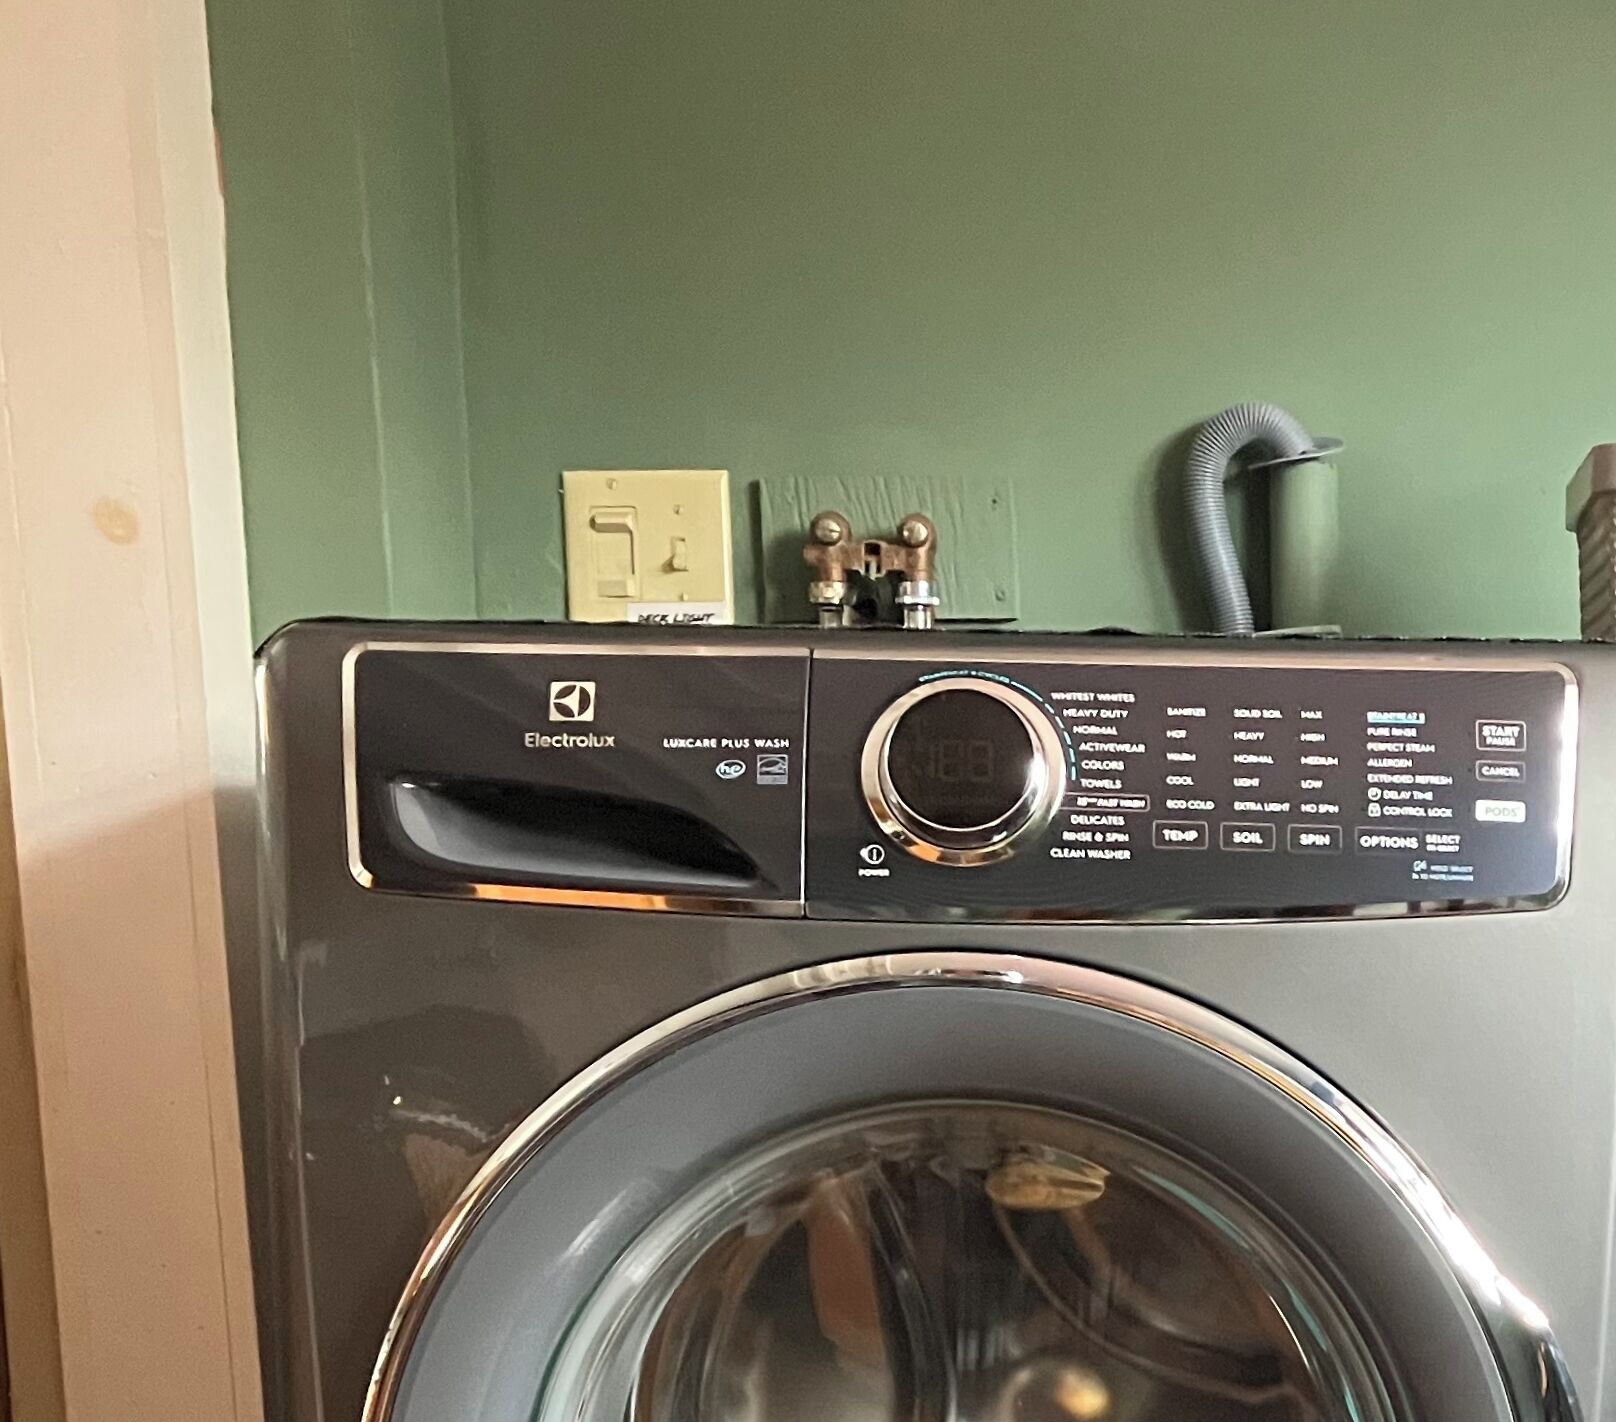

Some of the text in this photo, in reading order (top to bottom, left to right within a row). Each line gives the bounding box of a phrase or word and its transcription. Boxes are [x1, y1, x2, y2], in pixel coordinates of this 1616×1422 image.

[1051, 692, 1135, 703] WHITEST WHITES
[1063, 708, 1128, 718] HEAVY DUTY
[1073, 726, 1118, 735] NORMAL
[1166, 729, 1187, 738] HOT
[1233, 731, 1264, 740] HEAVY
[1482, 725, 1520, 738] START
[524, 733, 615, 748] Electrolux
[663, 738, 789, 748] LUXCARE PLUS WASH
[1486, 736, 1516, 746] PAUSE
[1078, 742, 1145, 753] ACTIVEWEAR
[1405, 743, 1435, 753] STEAM
[1233, 754, 1274, 764] NORMAL
[1367, 758, 1412, 768] ALLERGEN
[1081, 760, 1124, 770] COLORS
[1482, 765, 1520, 777] CANCEL
[1080, 778, 1122, 789] TOWELS
[1166, 776, 1194, 785] COOL
[1300, 780, 1323, 789] LOW
[1383, 790, 1411, 799] DELAY
[1166, 799, 1215, 810] ECO COLD
[1233, 801, 1263, 811] EXTRA
[1301, 803, 1317, 813] NO
[1383, 806, 1453, 817] CONTROL LOCK
[1070, 815, 1125, 826] DELICATES
[1063, 831, 1129, 842] RINSE & SPIN
[1162, 829, 1199, 841] TEMP
[1232, 831, 1263, 844] SOIL
[1299, 833, 1330, 846] SPIN
[1425, 834, 1460, 844] SELECT
[1360, 835, 1419, 849] OPTIONS
[1050, 848, 1131, 860] CLEAN WASHER
